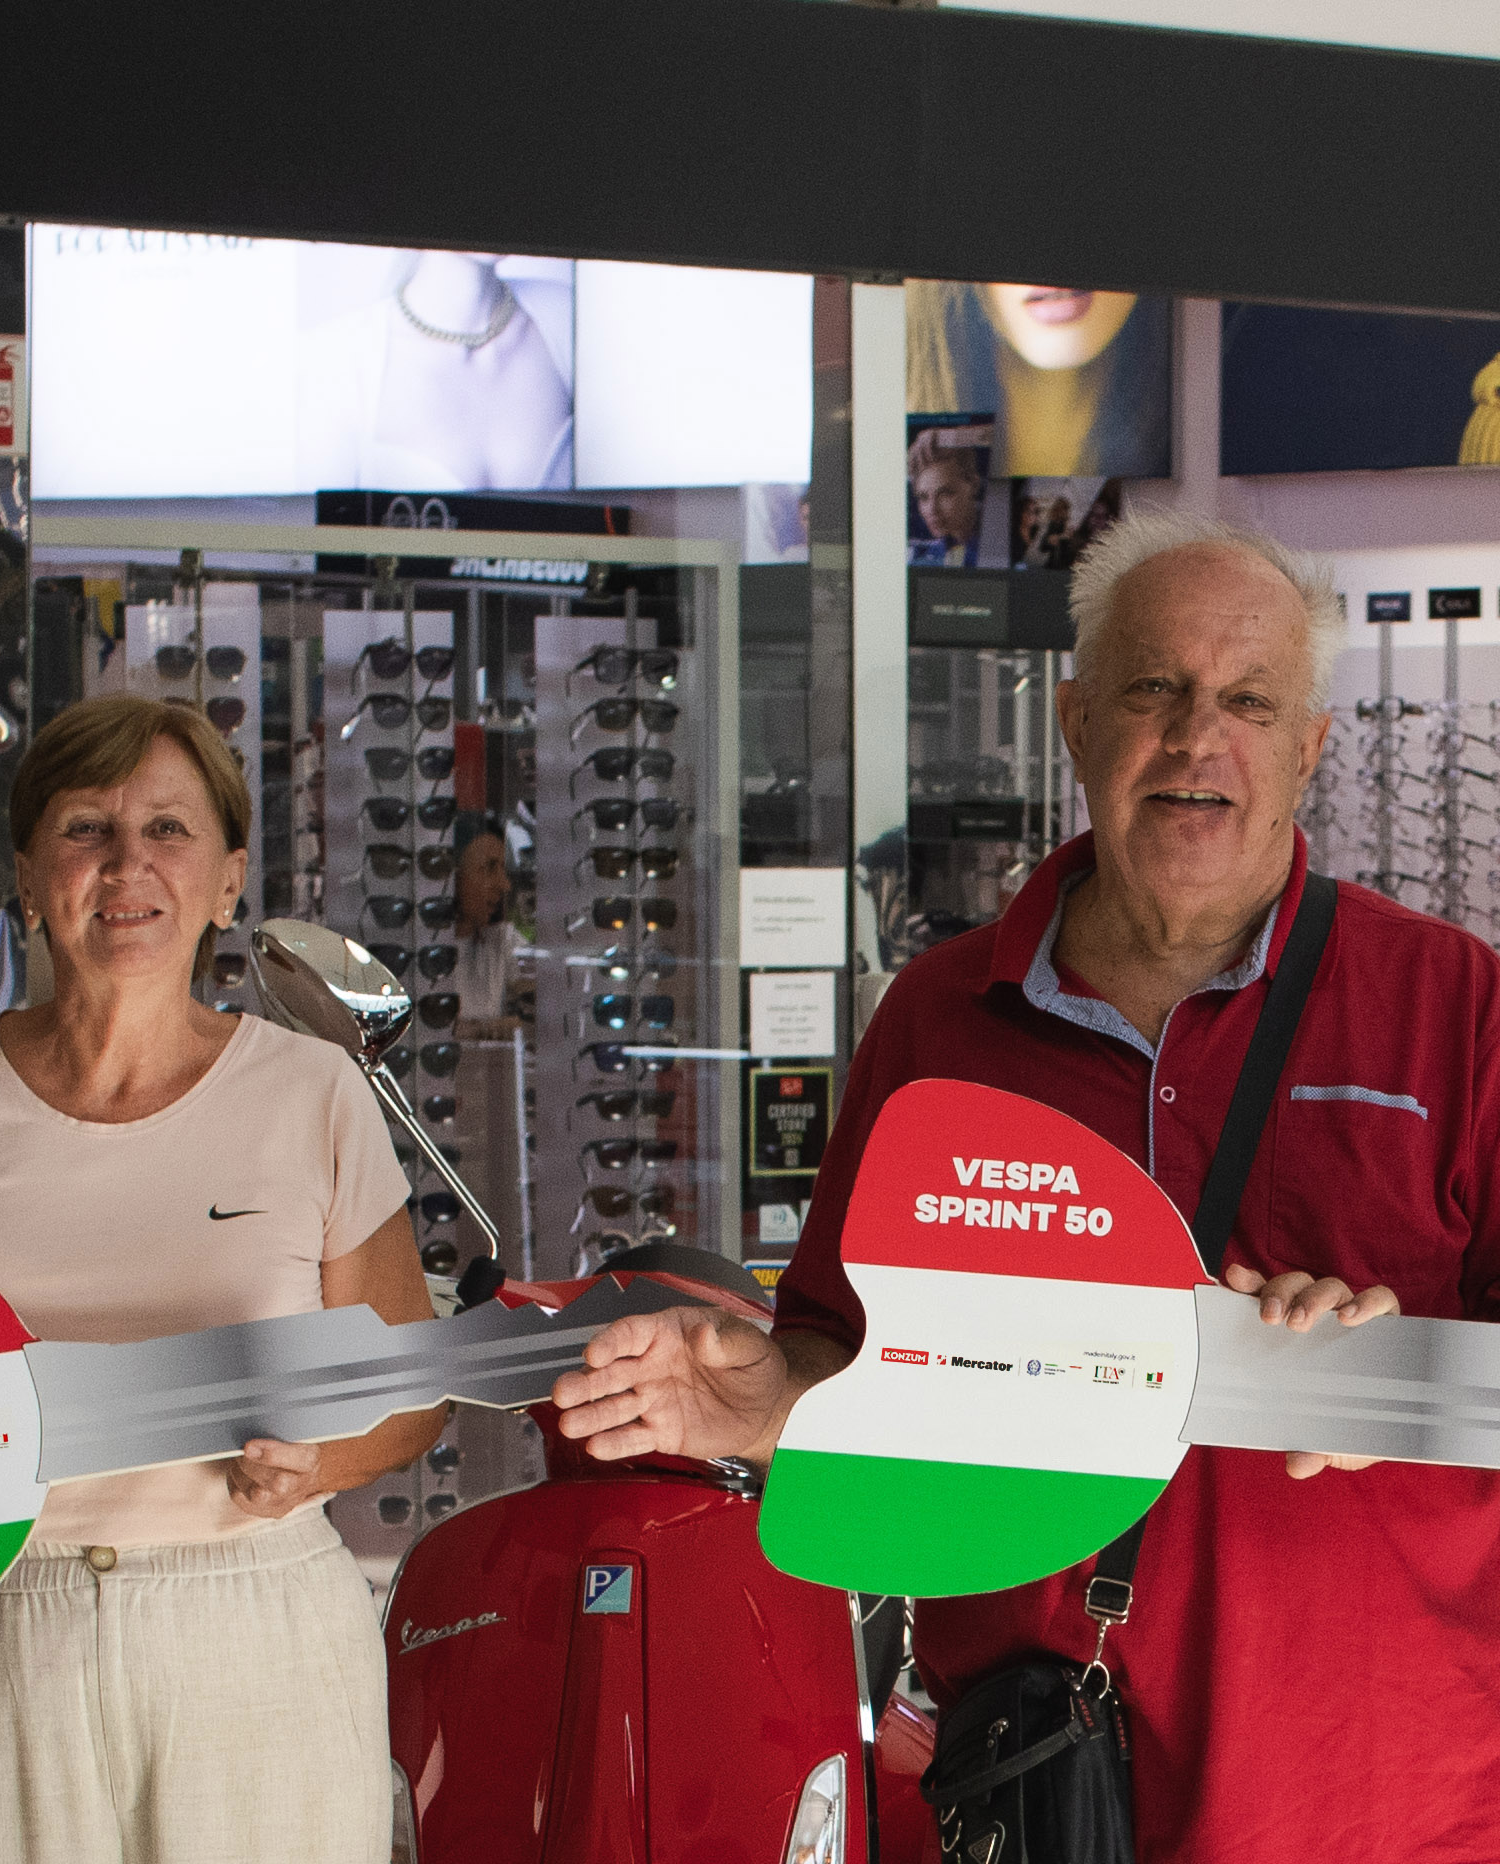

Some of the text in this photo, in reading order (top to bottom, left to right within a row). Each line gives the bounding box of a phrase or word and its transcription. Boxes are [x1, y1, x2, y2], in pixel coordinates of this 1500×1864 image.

[952, 1156, 1081, 1195] VESPA
[913, 1193, 1113, 1237] SPRINT 50
[883, 1350, 1014, 1372] KONZUM Mercator
